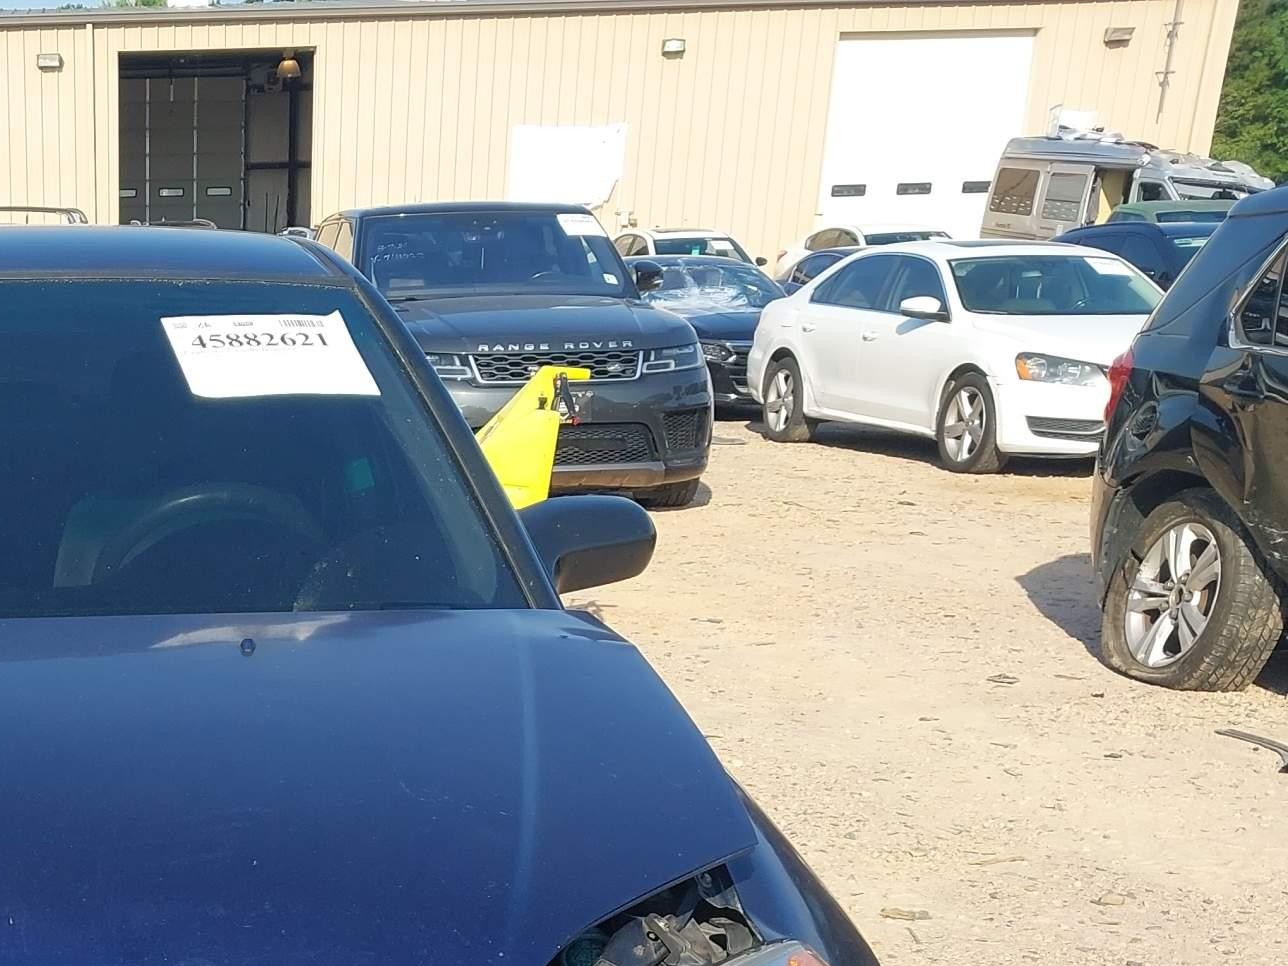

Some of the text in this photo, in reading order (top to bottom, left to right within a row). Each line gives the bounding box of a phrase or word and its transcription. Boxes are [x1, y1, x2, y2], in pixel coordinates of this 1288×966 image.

[191, 332, 328, 349] 45882621
[478, 340, 633, 352] RANGE ROVER
